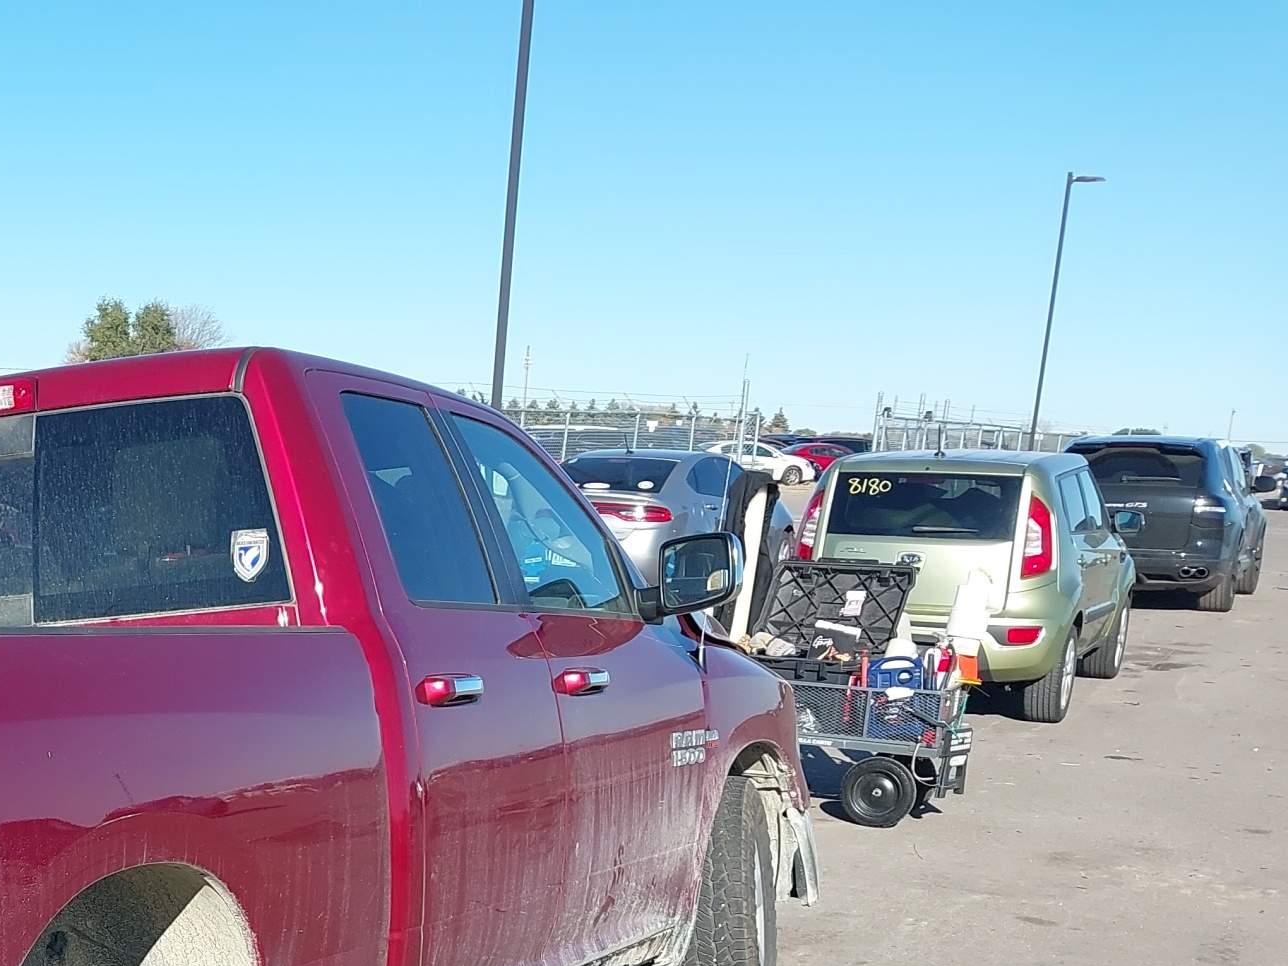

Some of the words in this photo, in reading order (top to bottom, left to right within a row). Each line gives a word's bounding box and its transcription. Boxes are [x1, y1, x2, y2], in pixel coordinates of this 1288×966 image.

[848, 477, 892, 495] 8180
[671, 730, 705, 748] RAM
[672, 748, 706, 767] 1500
